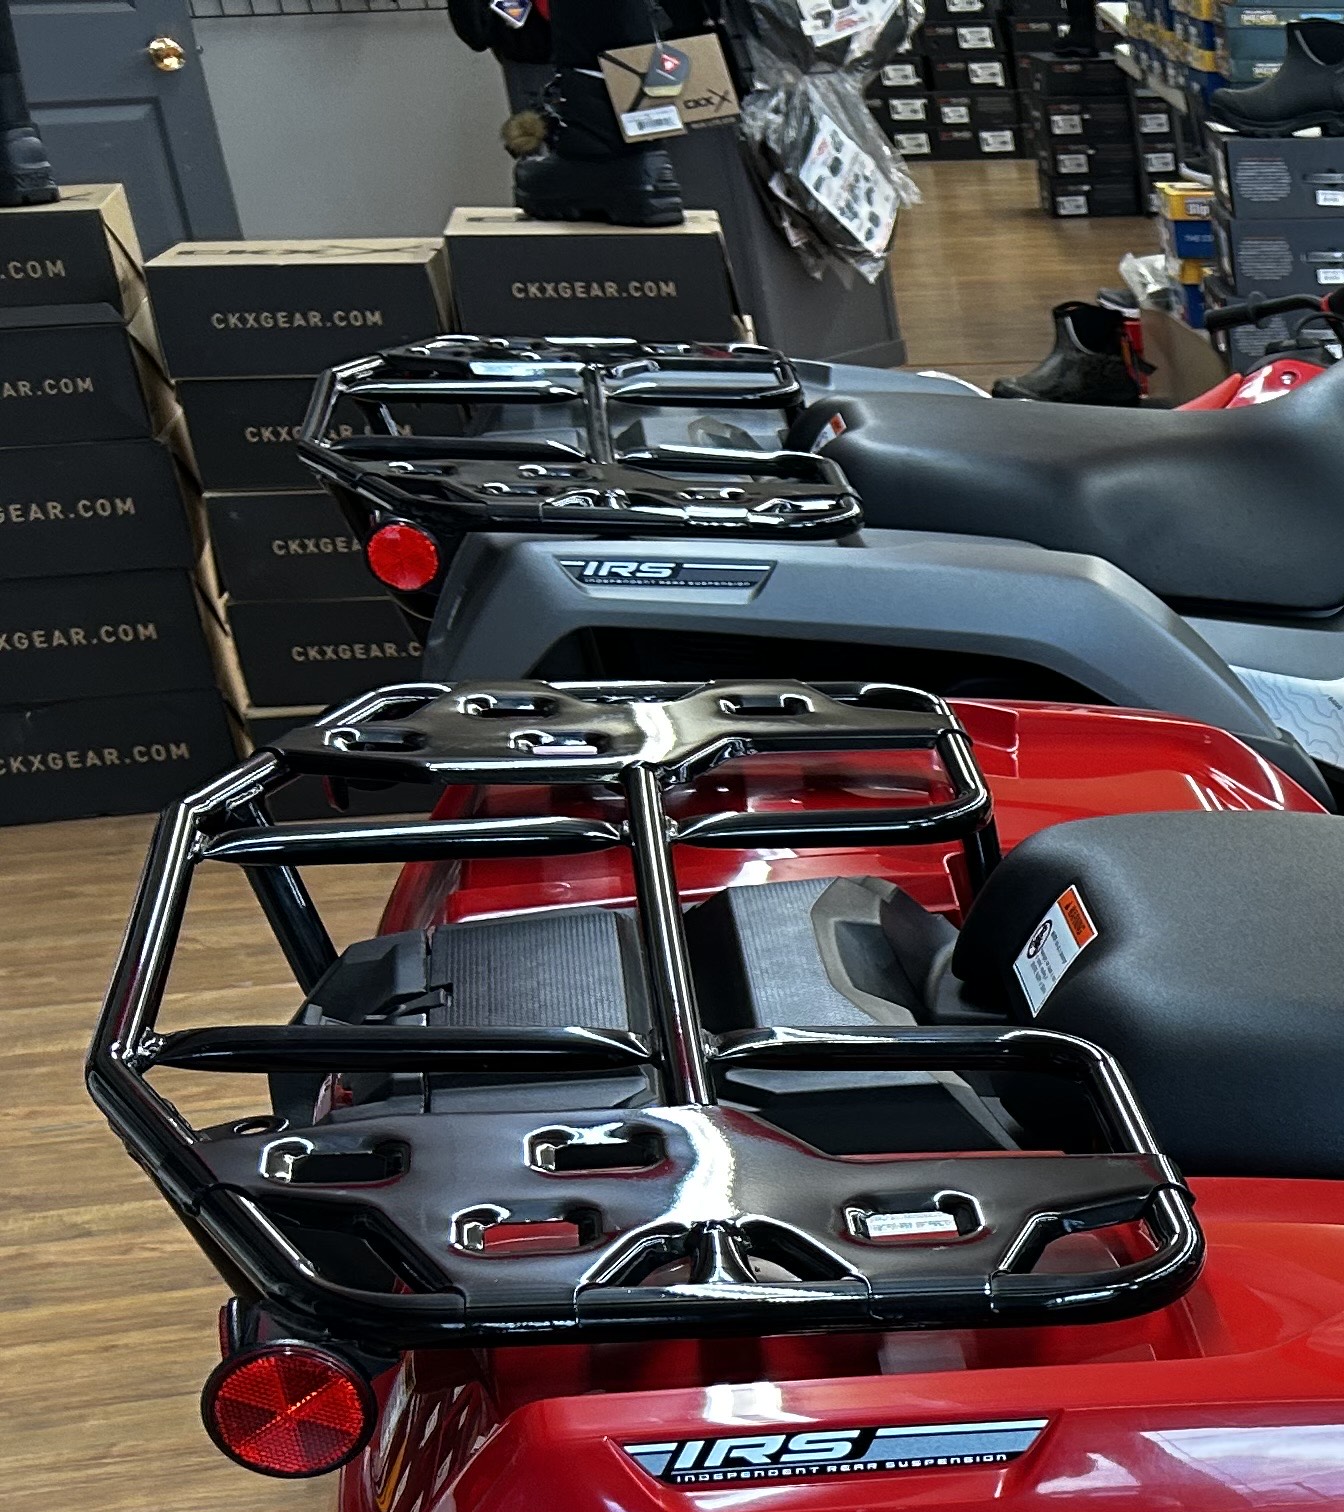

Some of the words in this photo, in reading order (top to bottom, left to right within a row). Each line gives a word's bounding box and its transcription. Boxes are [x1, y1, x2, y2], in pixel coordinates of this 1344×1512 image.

[511, 280, 678, 299] CKXGEAR.COM
[211, 310, 383, 330] CKXGEAR.COM
[583, 561, 677, 579] IRS
[673, 1429, 861, 1470] IRS
[676, 1465, 818, 1483] INDEPENDENT
[827, 1461, 878, 1474] REAR
[885, 1453, 1008, 1469] SUSPENSION
